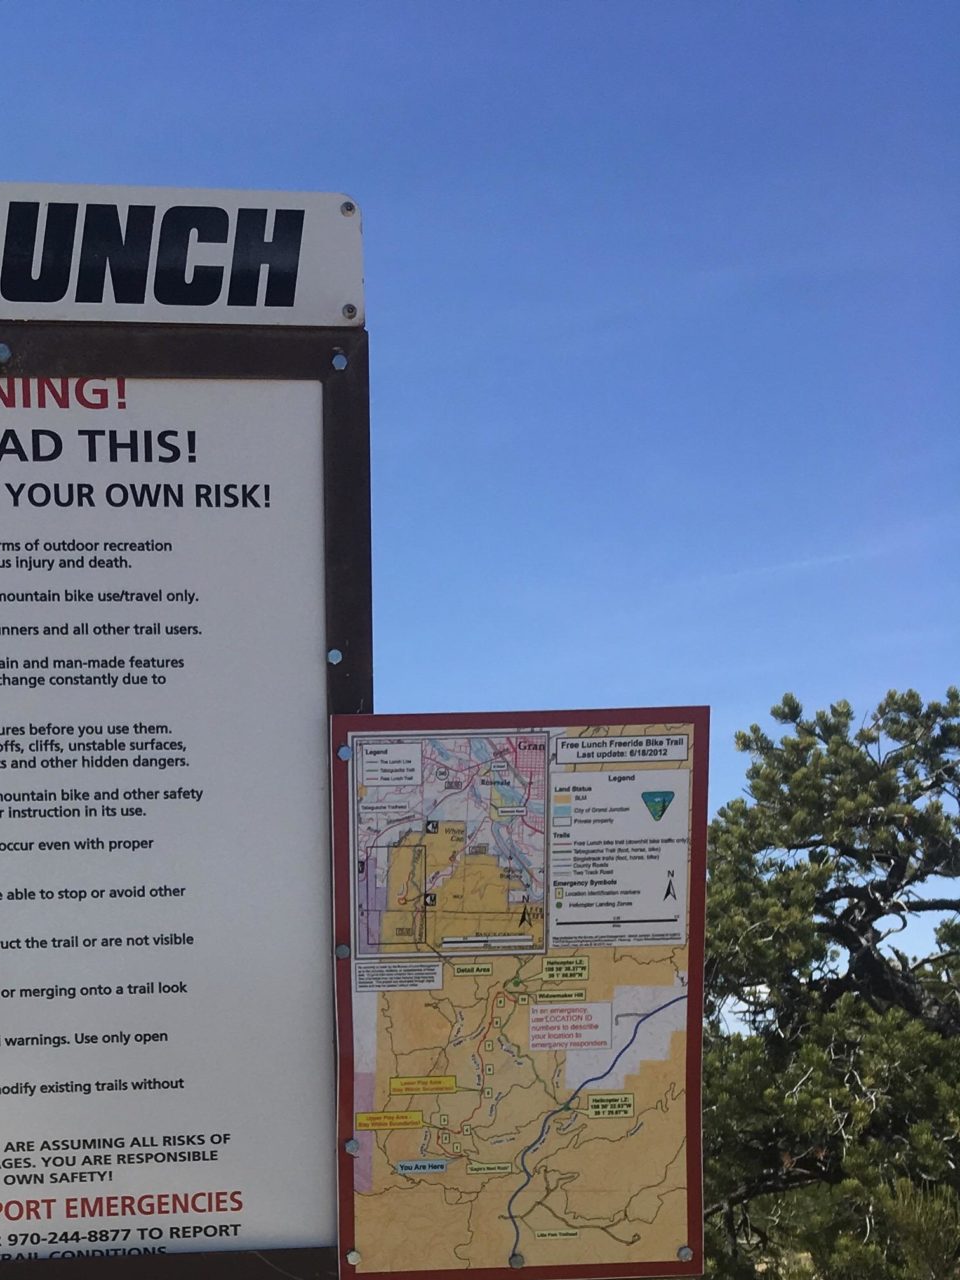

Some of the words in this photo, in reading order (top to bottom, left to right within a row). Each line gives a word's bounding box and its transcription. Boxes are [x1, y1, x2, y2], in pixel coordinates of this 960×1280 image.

[77, 429, 197, 464] THIS!
[3, 482, 96, 508] YOUR
[105, 482, 184, 508] OWN
[194, 483, 271, 509] RISK!
[64, 588, 95, 603] bike
[97, 588, 163, 603] use/travel
[165, 588, 200, 605] only.
[42, 622, 70, 636] and
[72, 622, 90, 636] all
[92, 622, 131, 636] other
[132, 622, 162, 636] trail
[164, 625, 203, 636] users.
[28, 738, 65, 754] cliffs,
[68, 737, 127, 752] unstable
[129, 737, 187, 753] surfaces,
[561, 741, 579, 749] Free
[581, 740, 607, 748] Lunch
[609, 740, 643, 748] Freeride
[645, 739, 664, 747] Bike
[665, 738, 684, 746] Trail
[577, 751, 595, 759] Last
[608, 775, 635, 783] Legend
[667, 869, 675, 878] N
[3, 1172, 45, 1186] OWN
[49, 1170, 113, 1184] SAFETY!
[65, 1190, 244, 1219] EMERGENCIES
[7, 1228, 132, 1247] 970-244-8877
[135, 1226, 164, 1241] TO
[169, 1223, 242, 1240] REPORT
